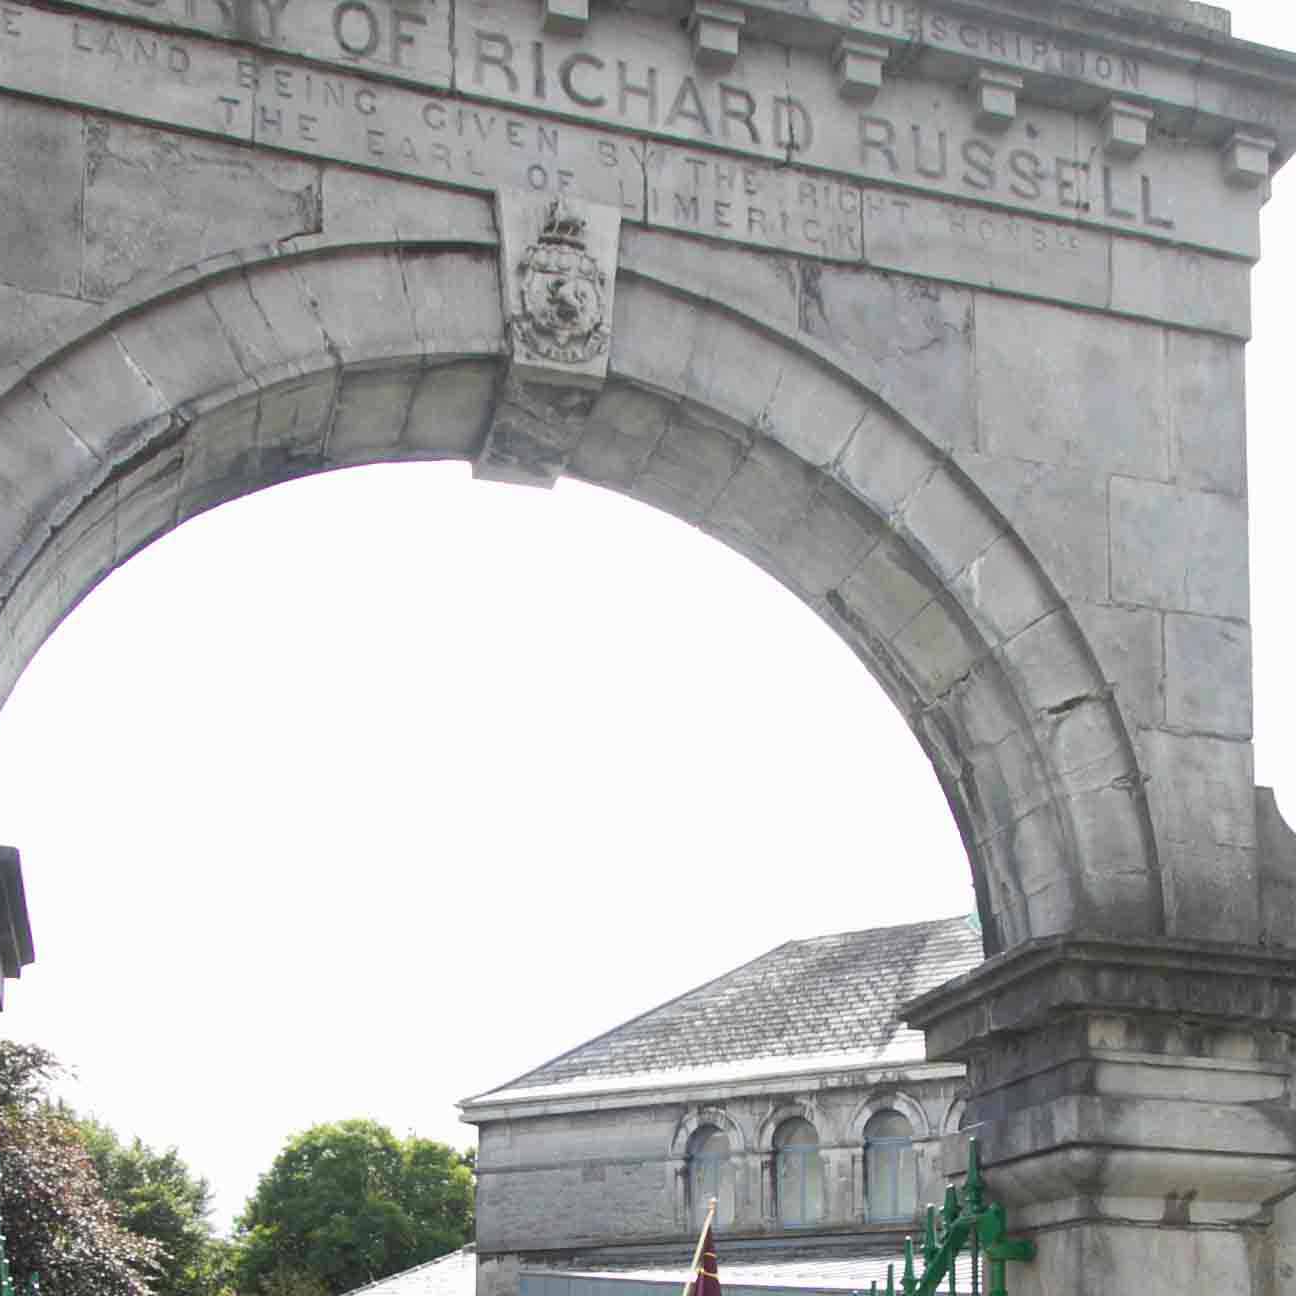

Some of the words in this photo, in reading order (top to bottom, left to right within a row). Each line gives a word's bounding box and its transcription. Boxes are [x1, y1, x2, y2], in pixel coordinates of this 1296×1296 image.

[71, 23, 191, 74] LAND
[237, 58, 377, 117] BEING
[420, 102, 560, 156] GIVEN
[598, 138, 656, 173] BY
[684, 156, 760, 196] THE
[217, 95, 319, 143] THE
[367, 128, 485, 177] EARL
[526, 163, 575, 193] OF
[617, 178, 858, 250] LIMERICK
[333, 1, 427, 66] OF
[473, 29, 814, 153] RICHARD
[858, 113, 1175, 229] RUSSELL
